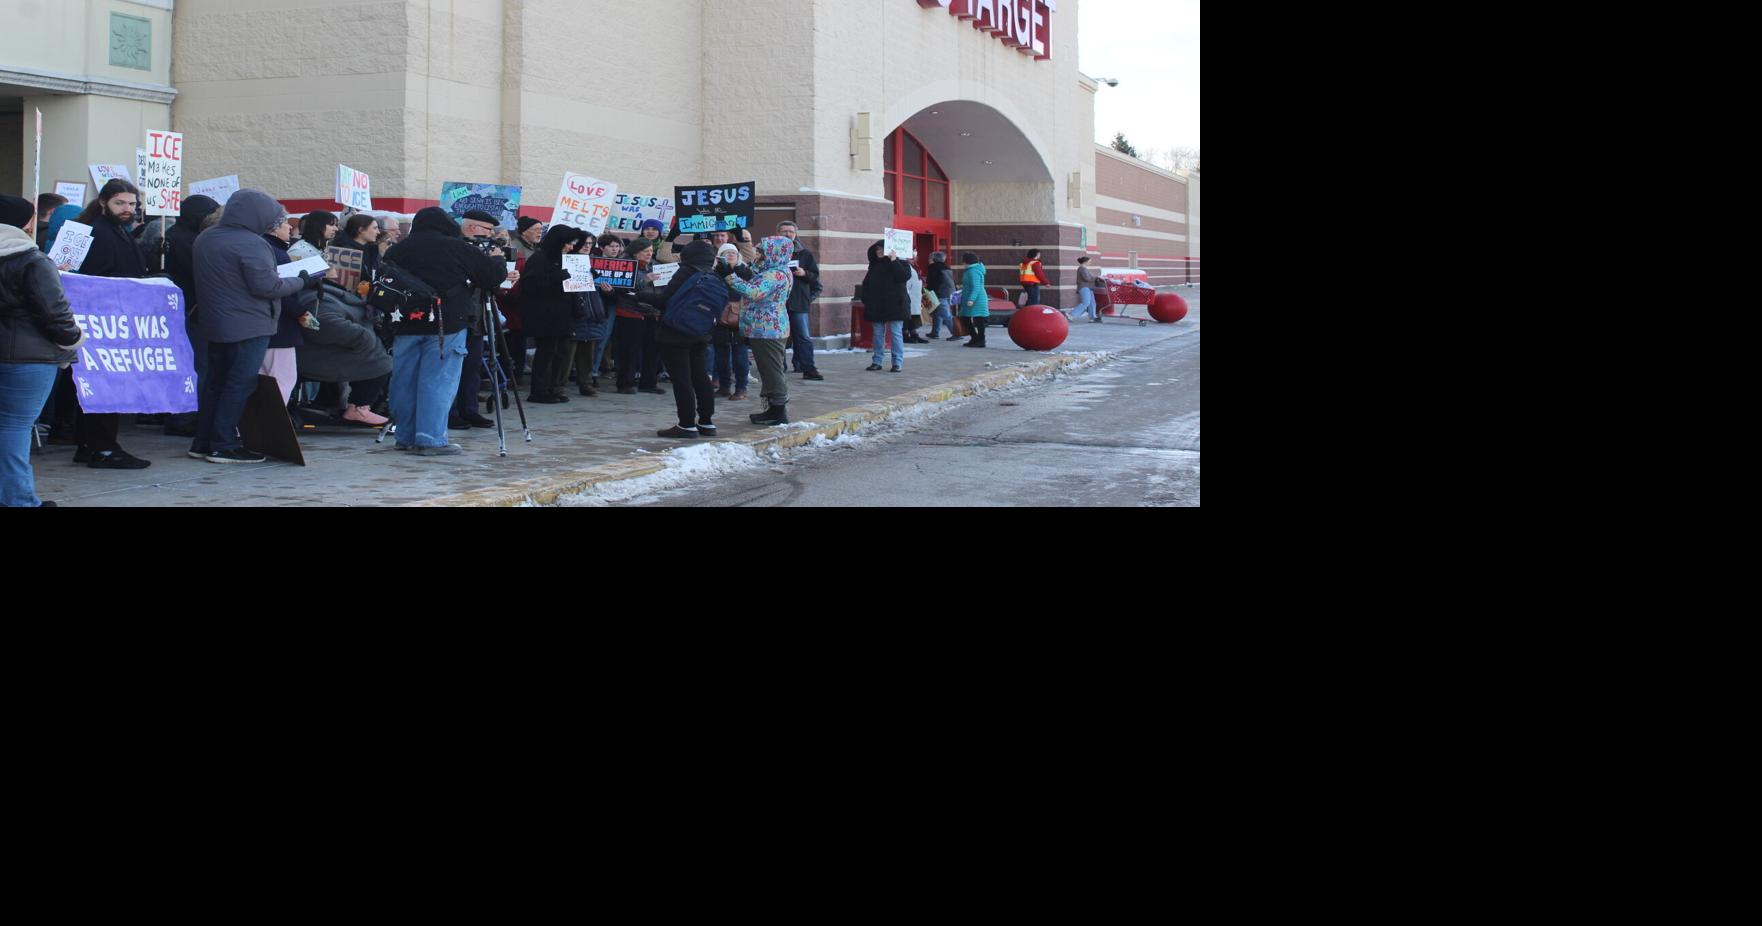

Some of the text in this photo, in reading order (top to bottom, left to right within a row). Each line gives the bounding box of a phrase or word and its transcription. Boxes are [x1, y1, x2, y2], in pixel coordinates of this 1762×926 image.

[966, 0, 1056, 60] ARGET
[149, 132, 182, 161] ICE
[147, 177, 170, 189] NONE
[352, 169, 368, 189] NO
[570, 181, 605, 196] LOVE
[158, 188, 180, 211] SAFE
[351, 191, 368, 209] ICE
[616, 194, 658, 208] JESUS
[681, 186, 750, 206] JESUS
[560, 196, 609, 218] MELTS
[621, 205, 640, 213] WAS
[561, 210, 601, 229] ICE
[328, 248, 362, 269] ICE
[613, 270, 624, 278] UP
[625, 271, 633, 279] OF
[73, 314, 169, 339] ESUS WAS
[81, 347, 177, 372] A REFUGEE
